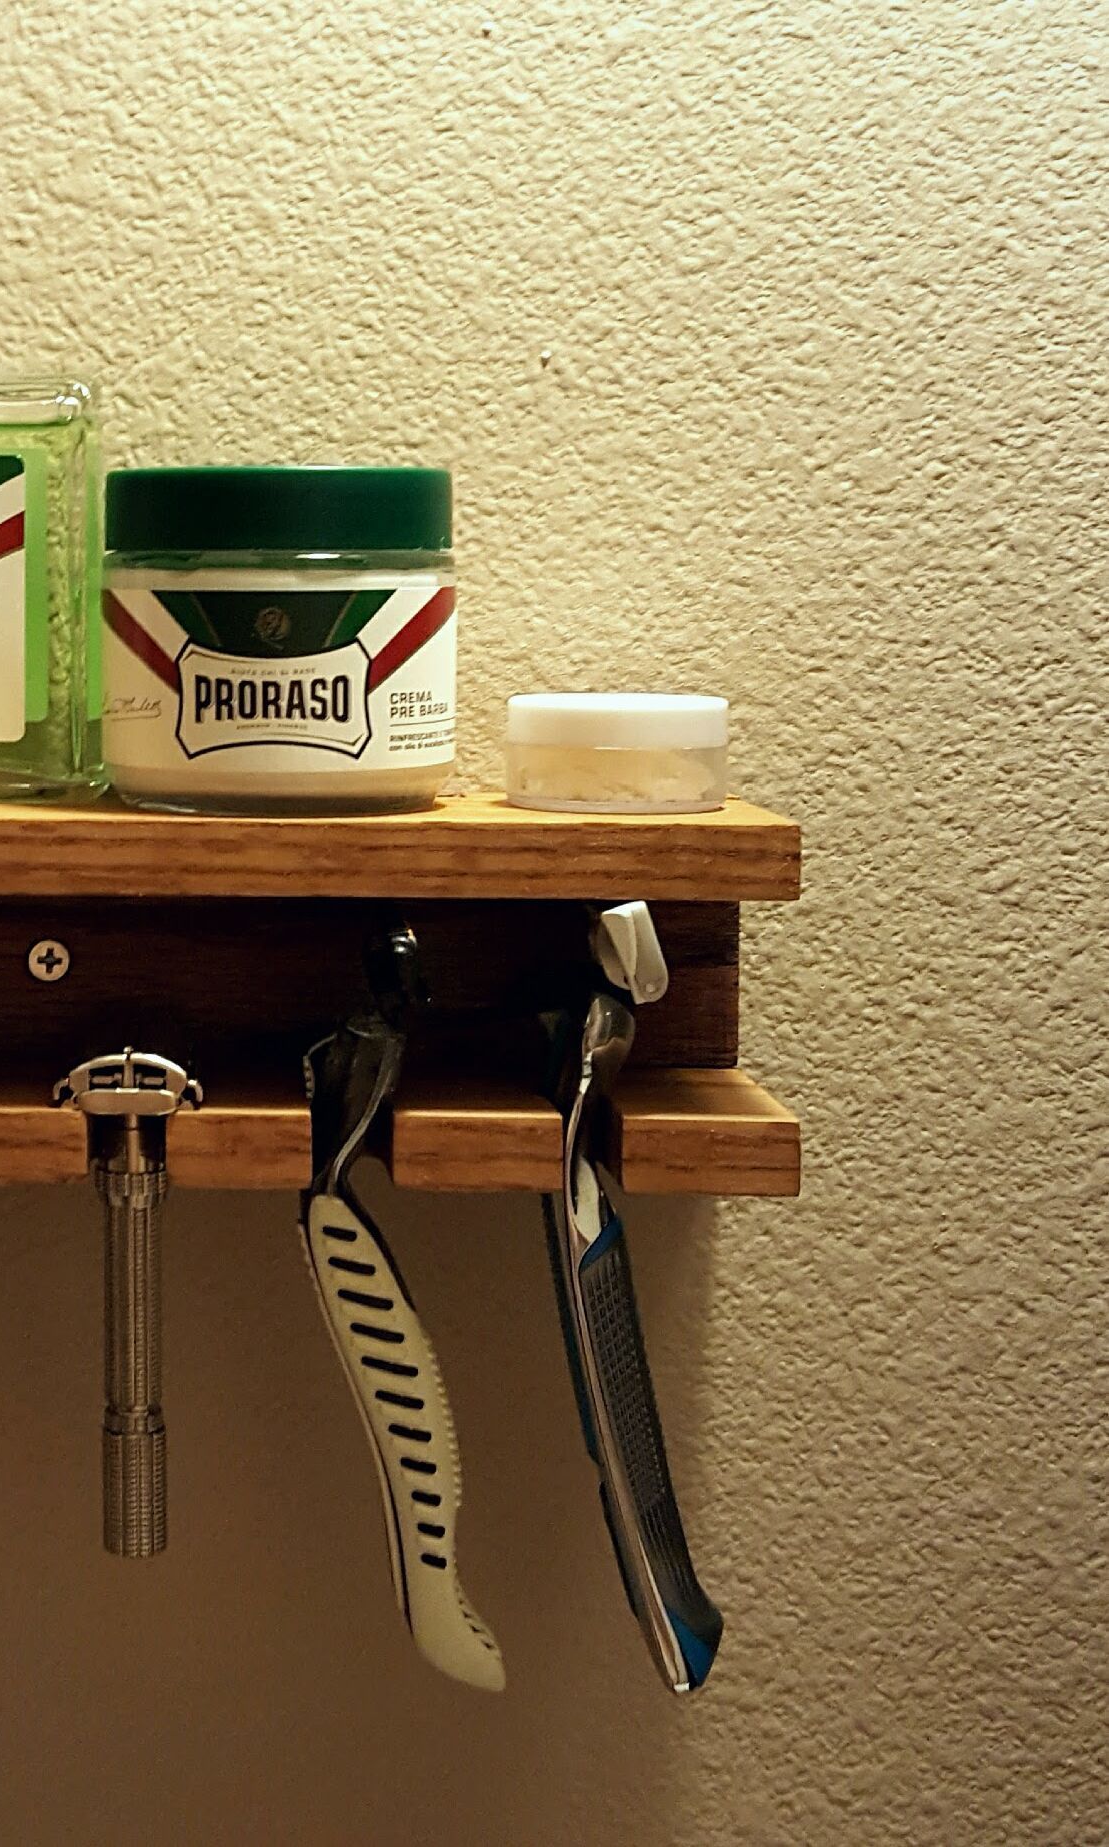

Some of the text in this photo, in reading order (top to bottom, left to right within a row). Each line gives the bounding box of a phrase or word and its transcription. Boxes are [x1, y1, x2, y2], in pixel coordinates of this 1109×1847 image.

[195, 674, 350, 723] PRORASO
[390, 691, 432, 705] CREMA
[390, 706, 415, 718] PRE
